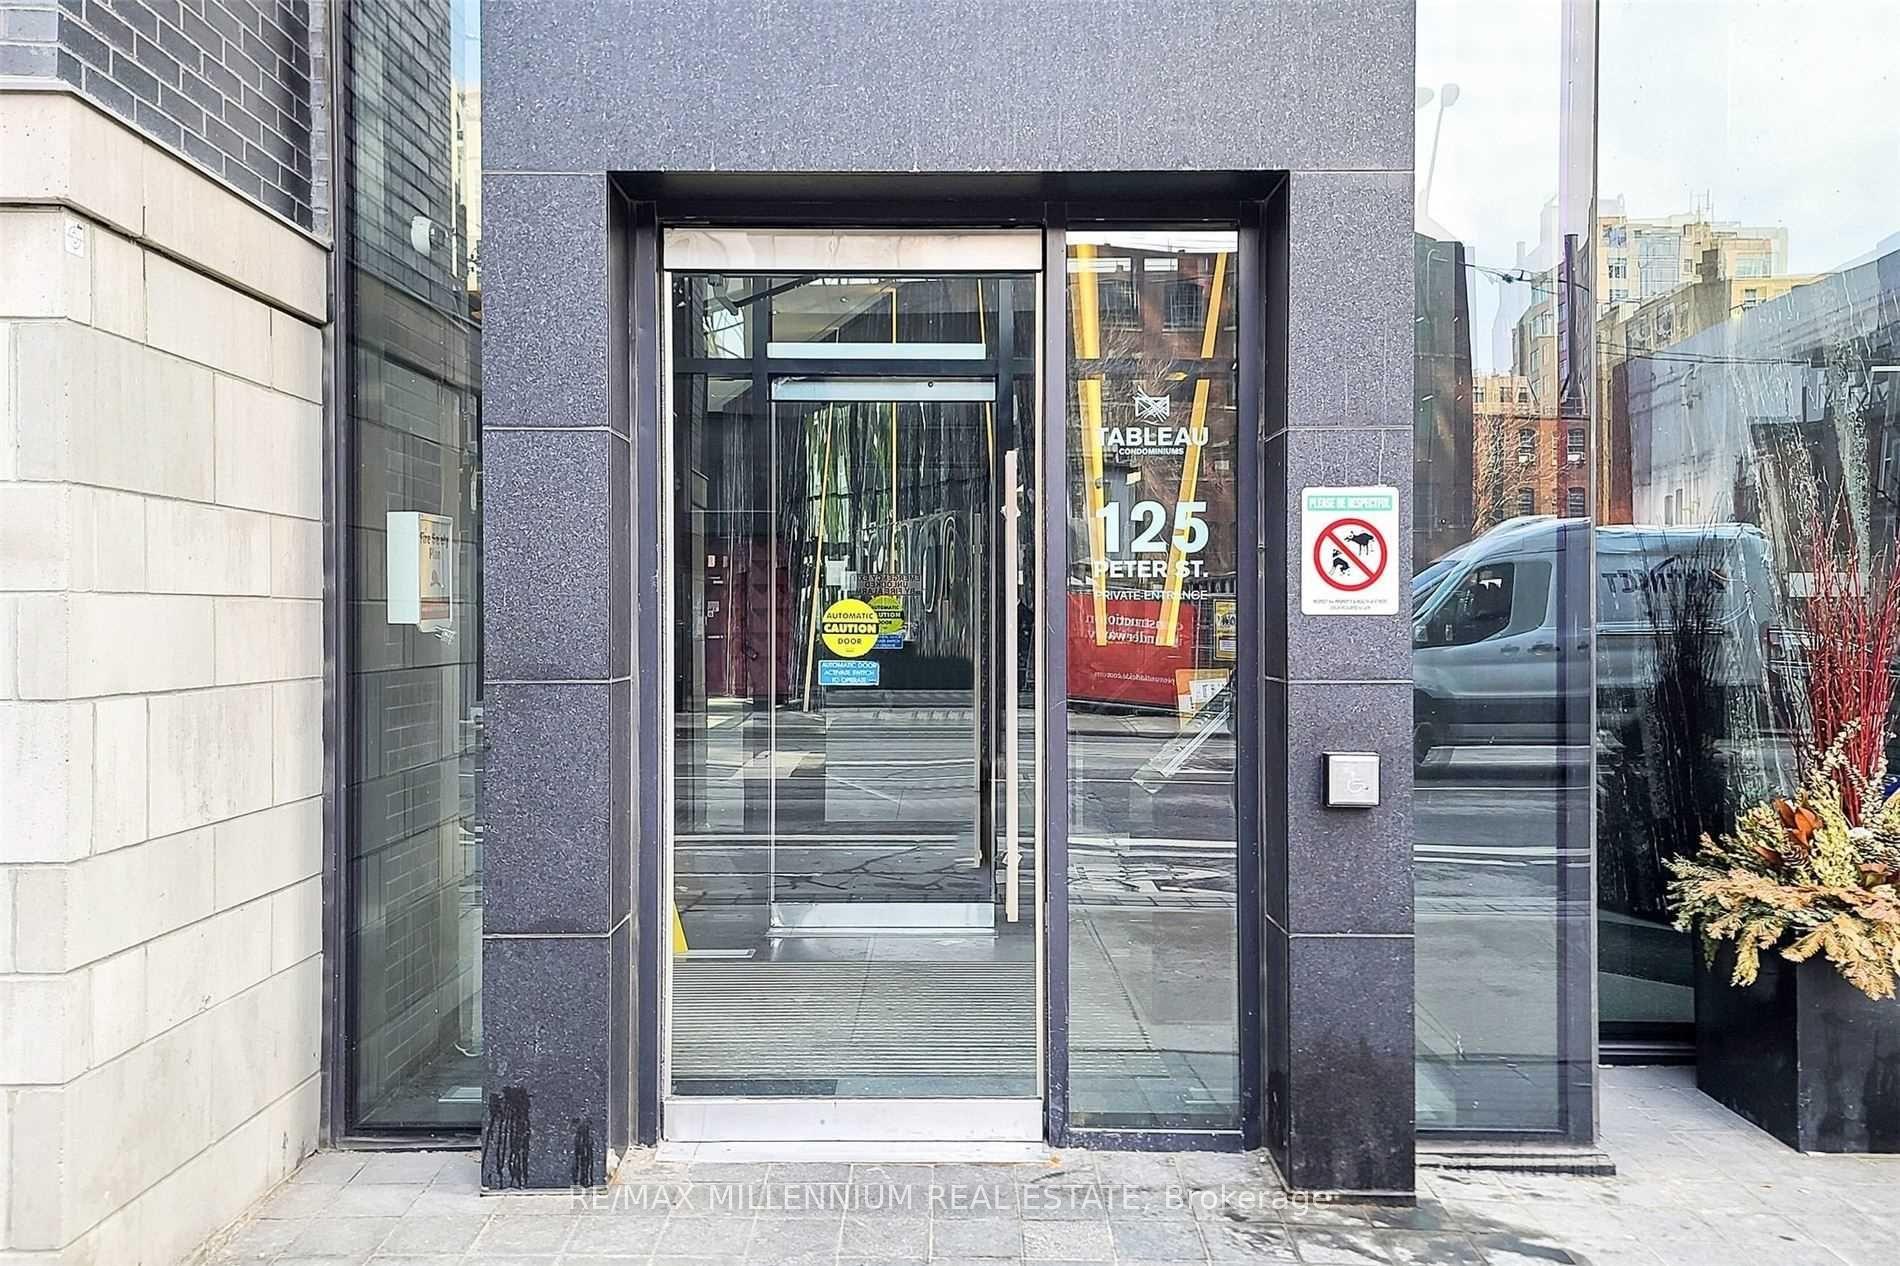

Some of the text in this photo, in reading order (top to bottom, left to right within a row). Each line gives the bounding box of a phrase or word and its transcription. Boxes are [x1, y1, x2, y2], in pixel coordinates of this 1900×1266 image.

[1096, 427, 1209, 447] TABLEAU
[1118, 447, 1185, 456] CONDOMINIUMS
[1095, 500, 1210, 554] 125
[1094, 560, 1209, 578] PETER ST.
[1095, 590, 1208, 600] PRIVATE ENTRANCE
[826, 612, 874, 620] AUTOMATIC
[823, 623, 877, 634] CAUTION
